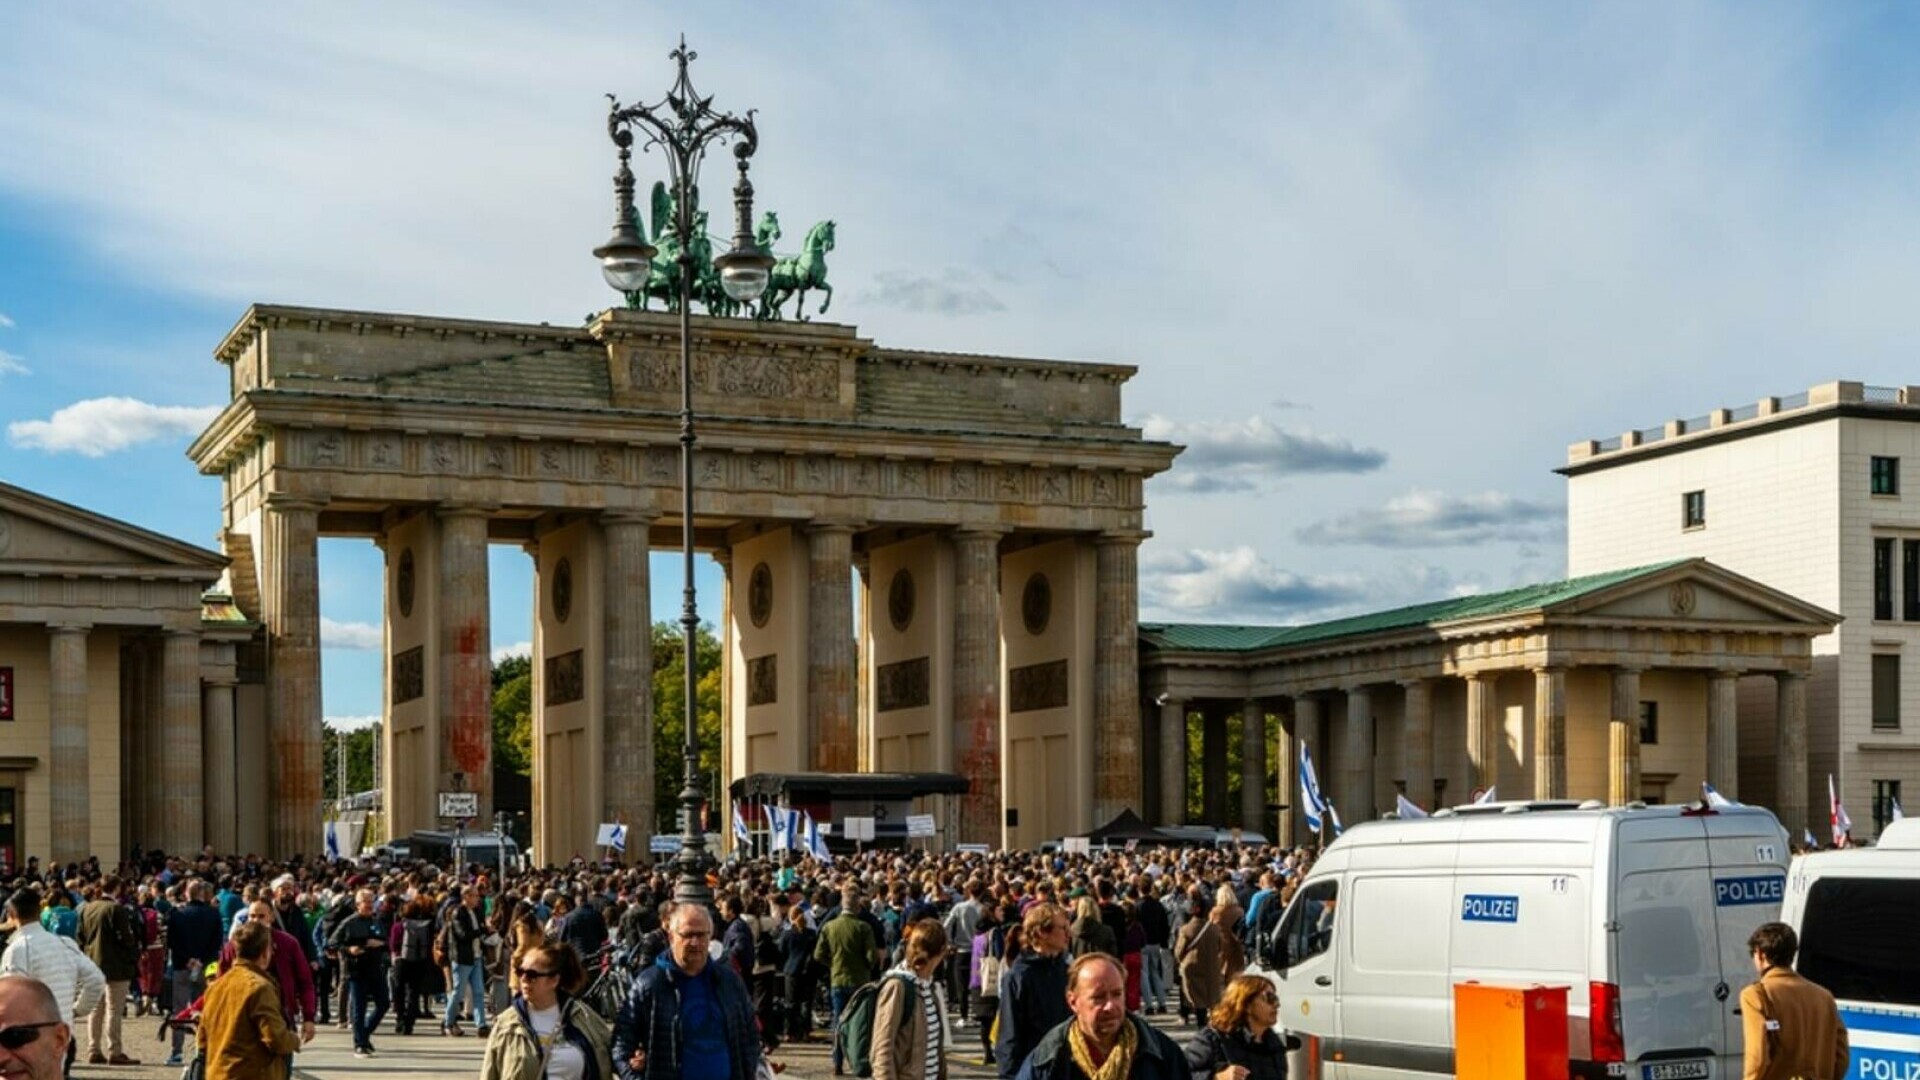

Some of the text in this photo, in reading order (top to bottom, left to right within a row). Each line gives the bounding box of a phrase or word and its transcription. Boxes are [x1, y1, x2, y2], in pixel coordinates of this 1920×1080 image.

[1758, 848, 1773, 860] 11
[1552, 878, 1565, 891] 11
[1717, 880, 1785, 901] POLIZEI
[1464, 899, 1517, 918] POLIZEI
